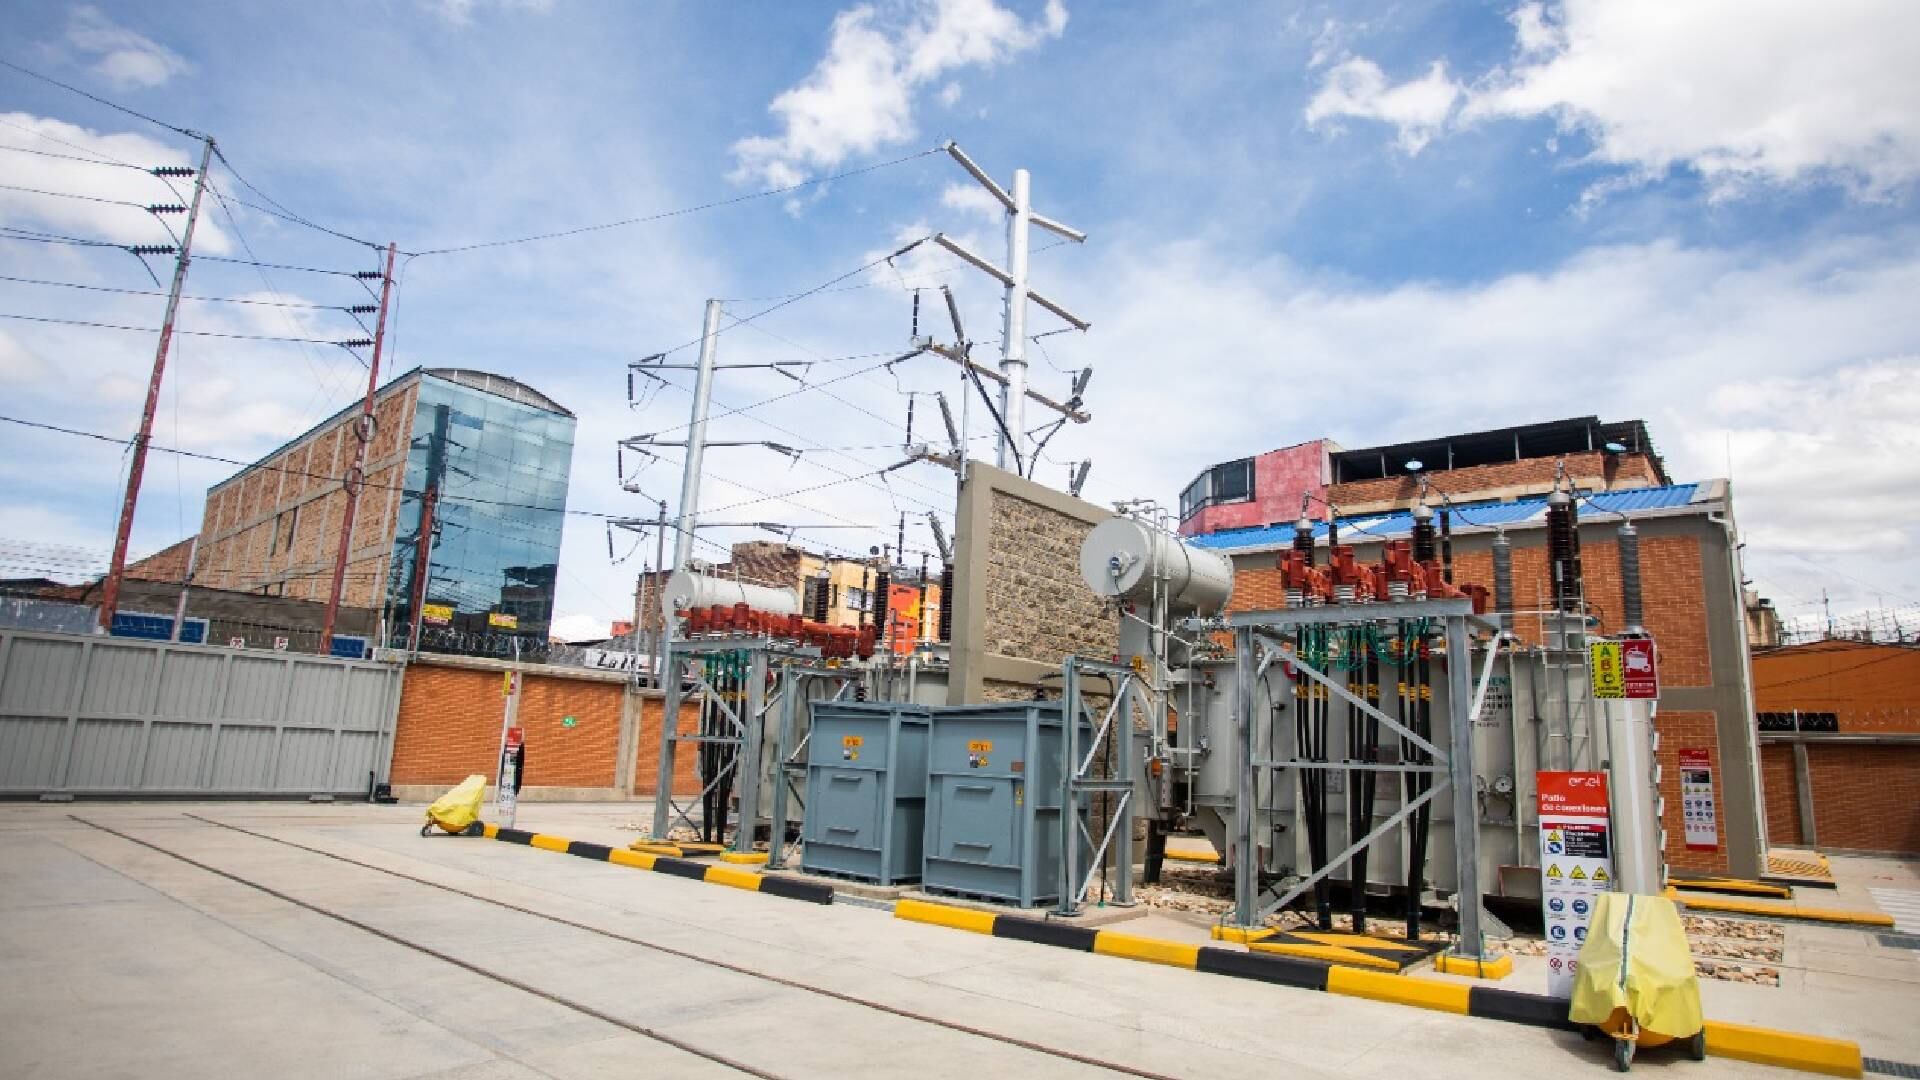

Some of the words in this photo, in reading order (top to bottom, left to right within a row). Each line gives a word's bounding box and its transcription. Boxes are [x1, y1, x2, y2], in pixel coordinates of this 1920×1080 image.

[1600, 646, 1612, 657] A
[1600, 659, 1612, 671] B
[1602, 673, 1616, 685] C
[1541, 793, 1566, 802] Patio
[1555, 804, 1607, 813] conexiones
